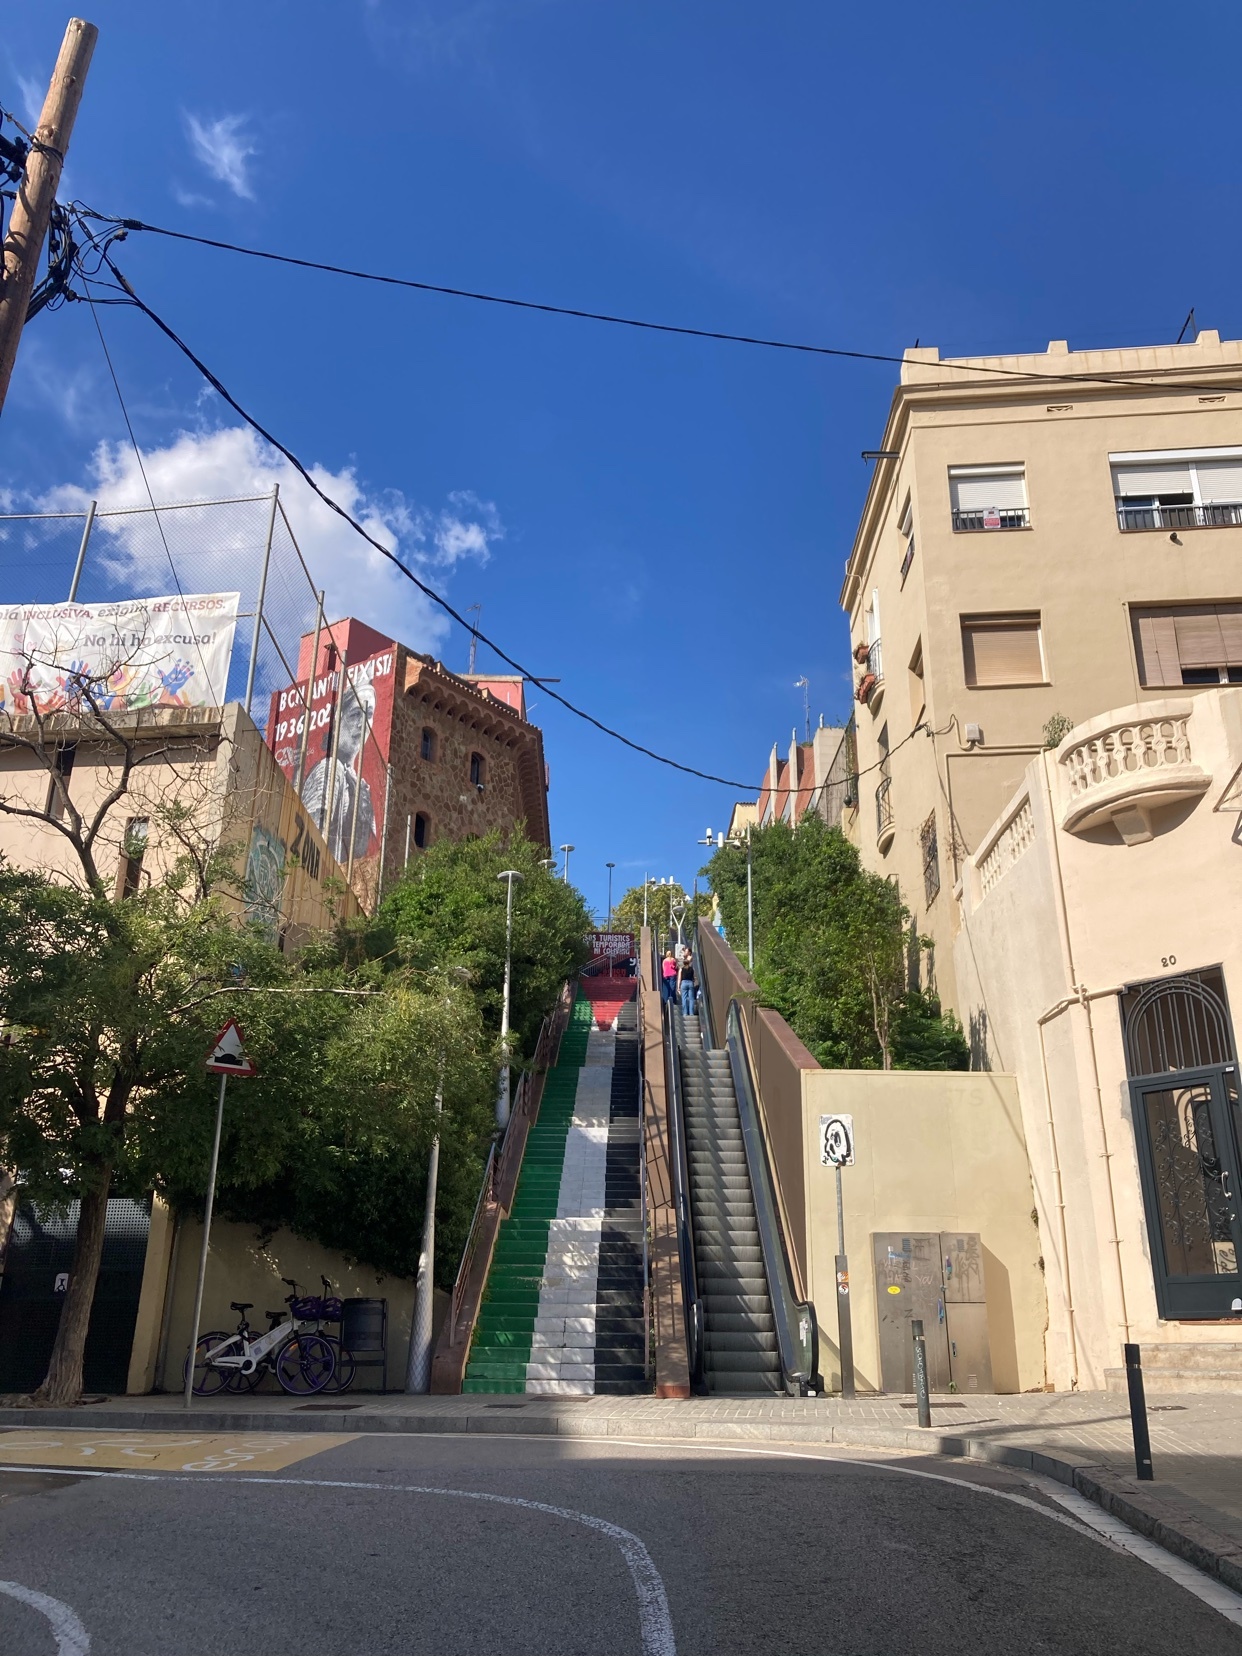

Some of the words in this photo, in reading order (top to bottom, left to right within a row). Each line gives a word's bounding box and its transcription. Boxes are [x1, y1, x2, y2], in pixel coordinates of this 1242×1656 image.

[152, 599, 226, 613] RECURSOS.
[83, 633, 106, 647] No
[109, 633, 127, 647] hi
[154, 632, 217, 645] excusa!
[279, 685, 305, 712] BCN
[275, 714, 305, 742] 1936
[1161, 955, 1176, 968] 20
